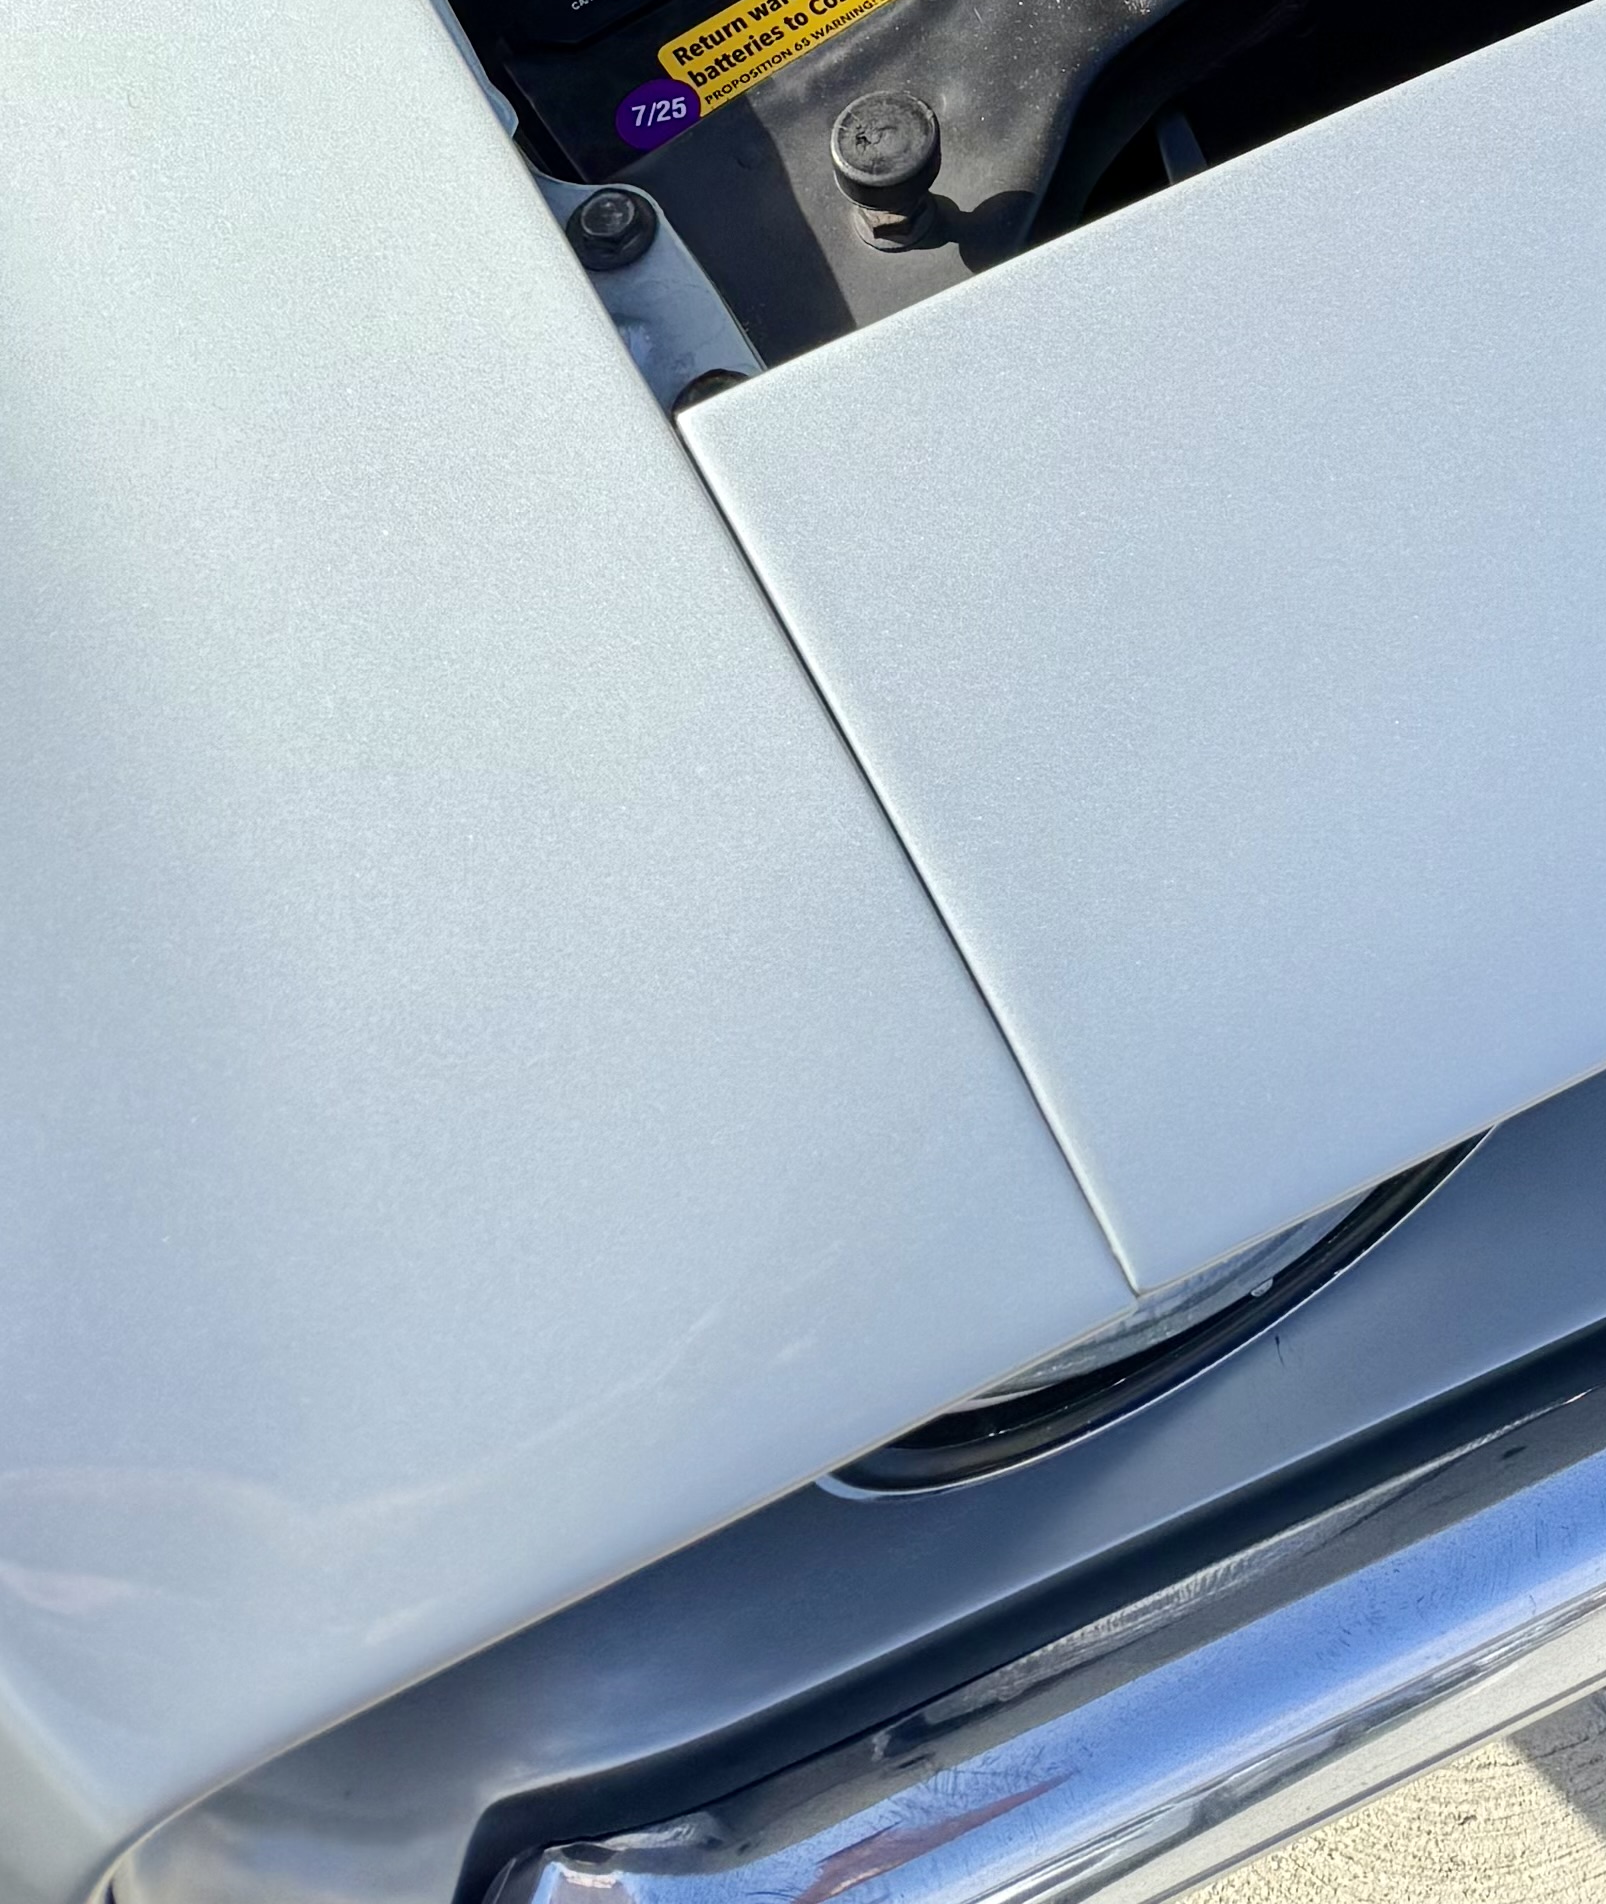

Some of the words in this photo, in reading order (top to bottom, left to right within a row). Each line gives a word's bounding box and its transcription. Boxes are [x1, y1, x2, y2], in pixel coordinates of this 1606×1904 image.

[671, 11, 748, 66] Return
[686, 19, 786, 88] batteries
[781, 6, 810, 33] to
[703, 47, 793, 105] PROPOSITION
[631, 95, 688, 126] 7/25
